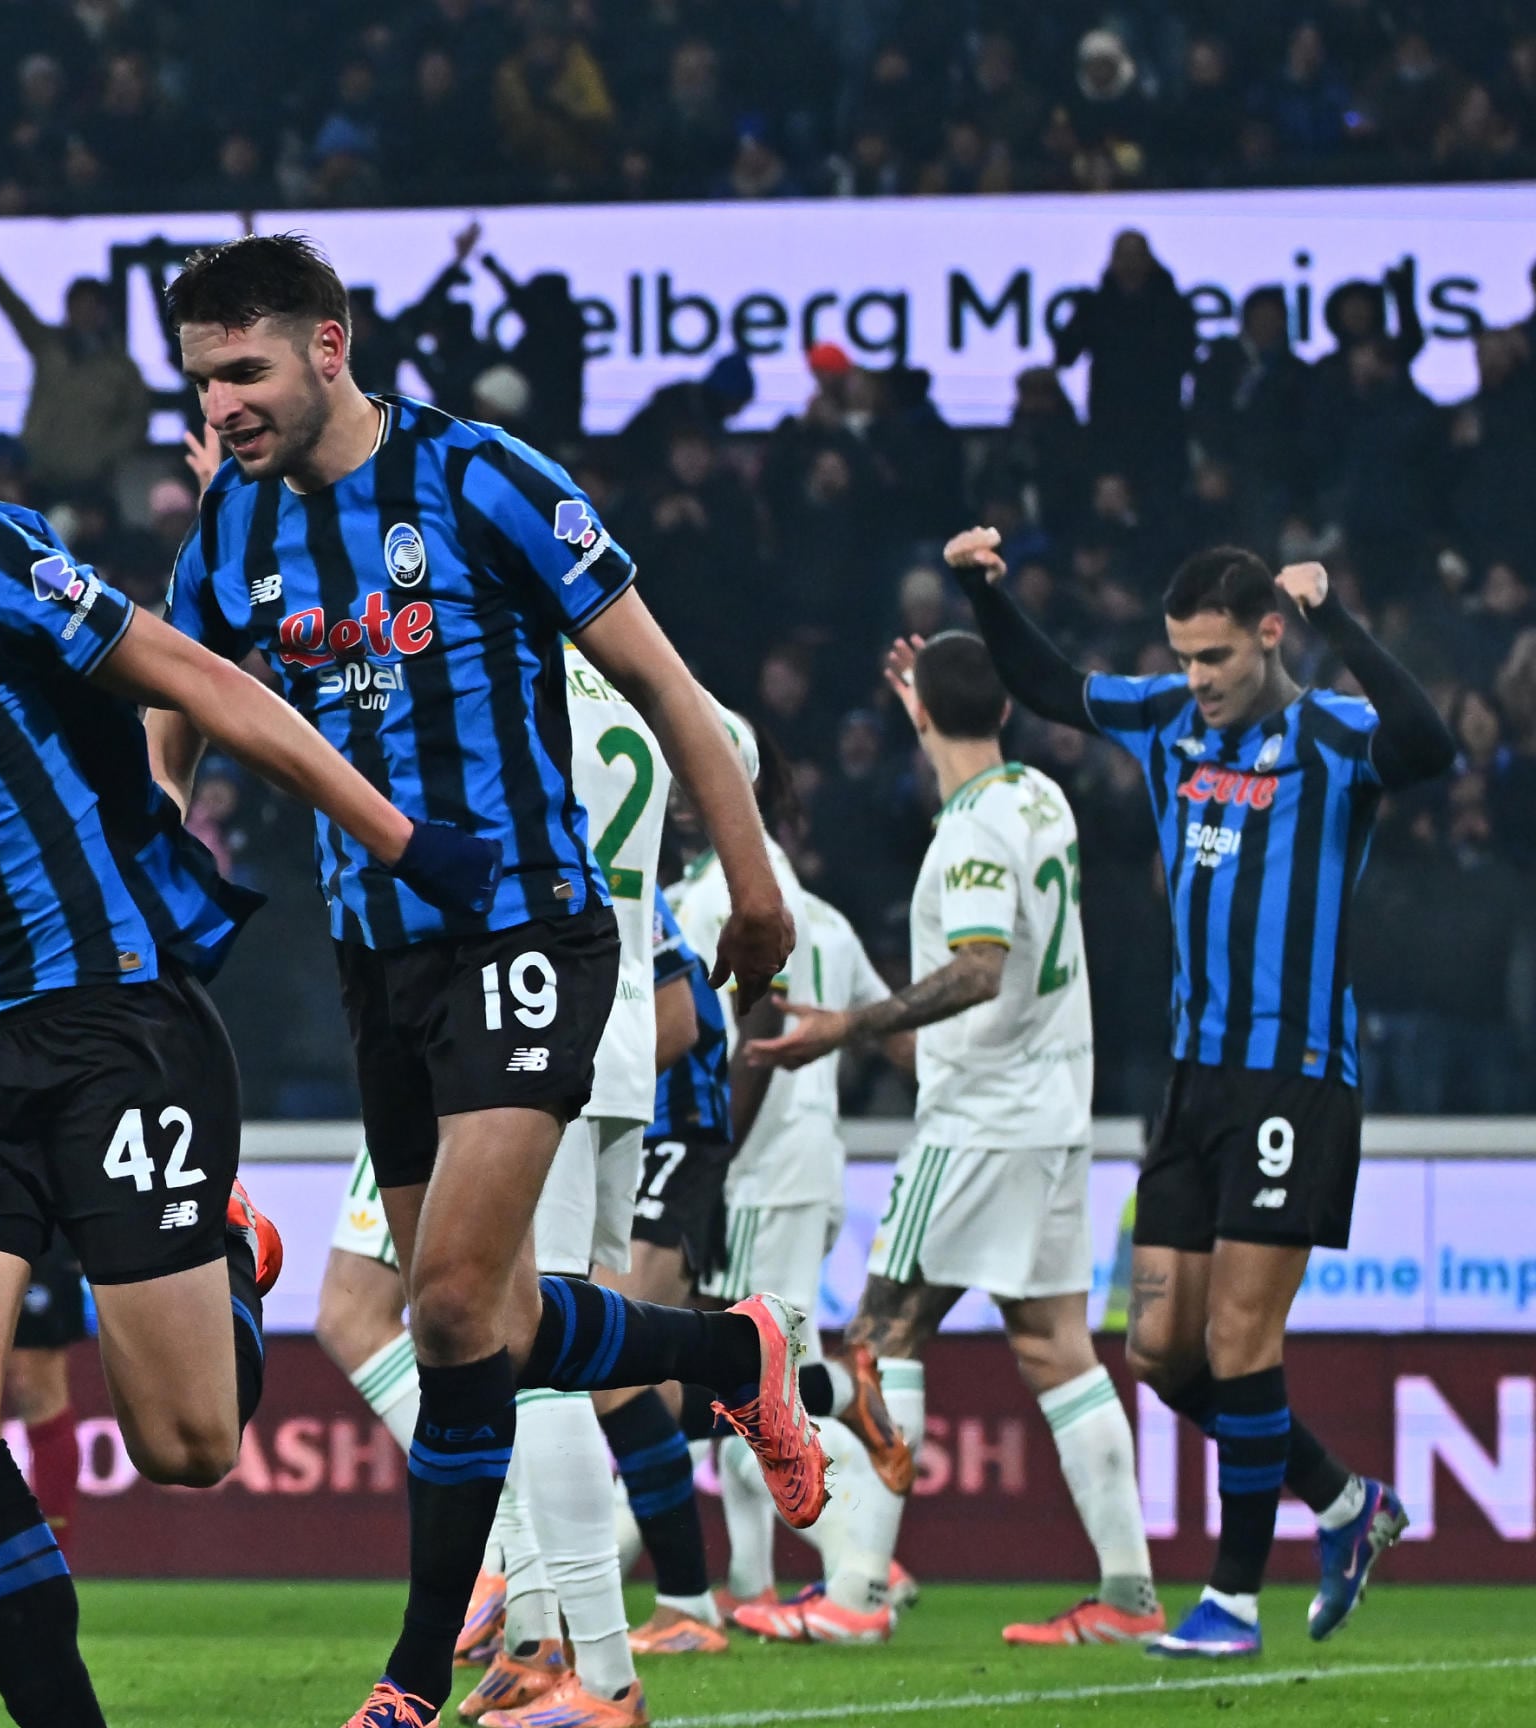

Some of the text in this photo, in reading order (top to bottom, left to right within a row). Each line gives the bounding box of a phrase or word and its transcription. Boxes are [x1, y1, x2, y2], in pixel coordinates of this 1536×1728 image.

[593, 725, 655, 901] 2
[481, 950, 558, 1031] 19
[102, 1105, 208, 1193] 42
[1257, 1115, 1295, 1178] 9
